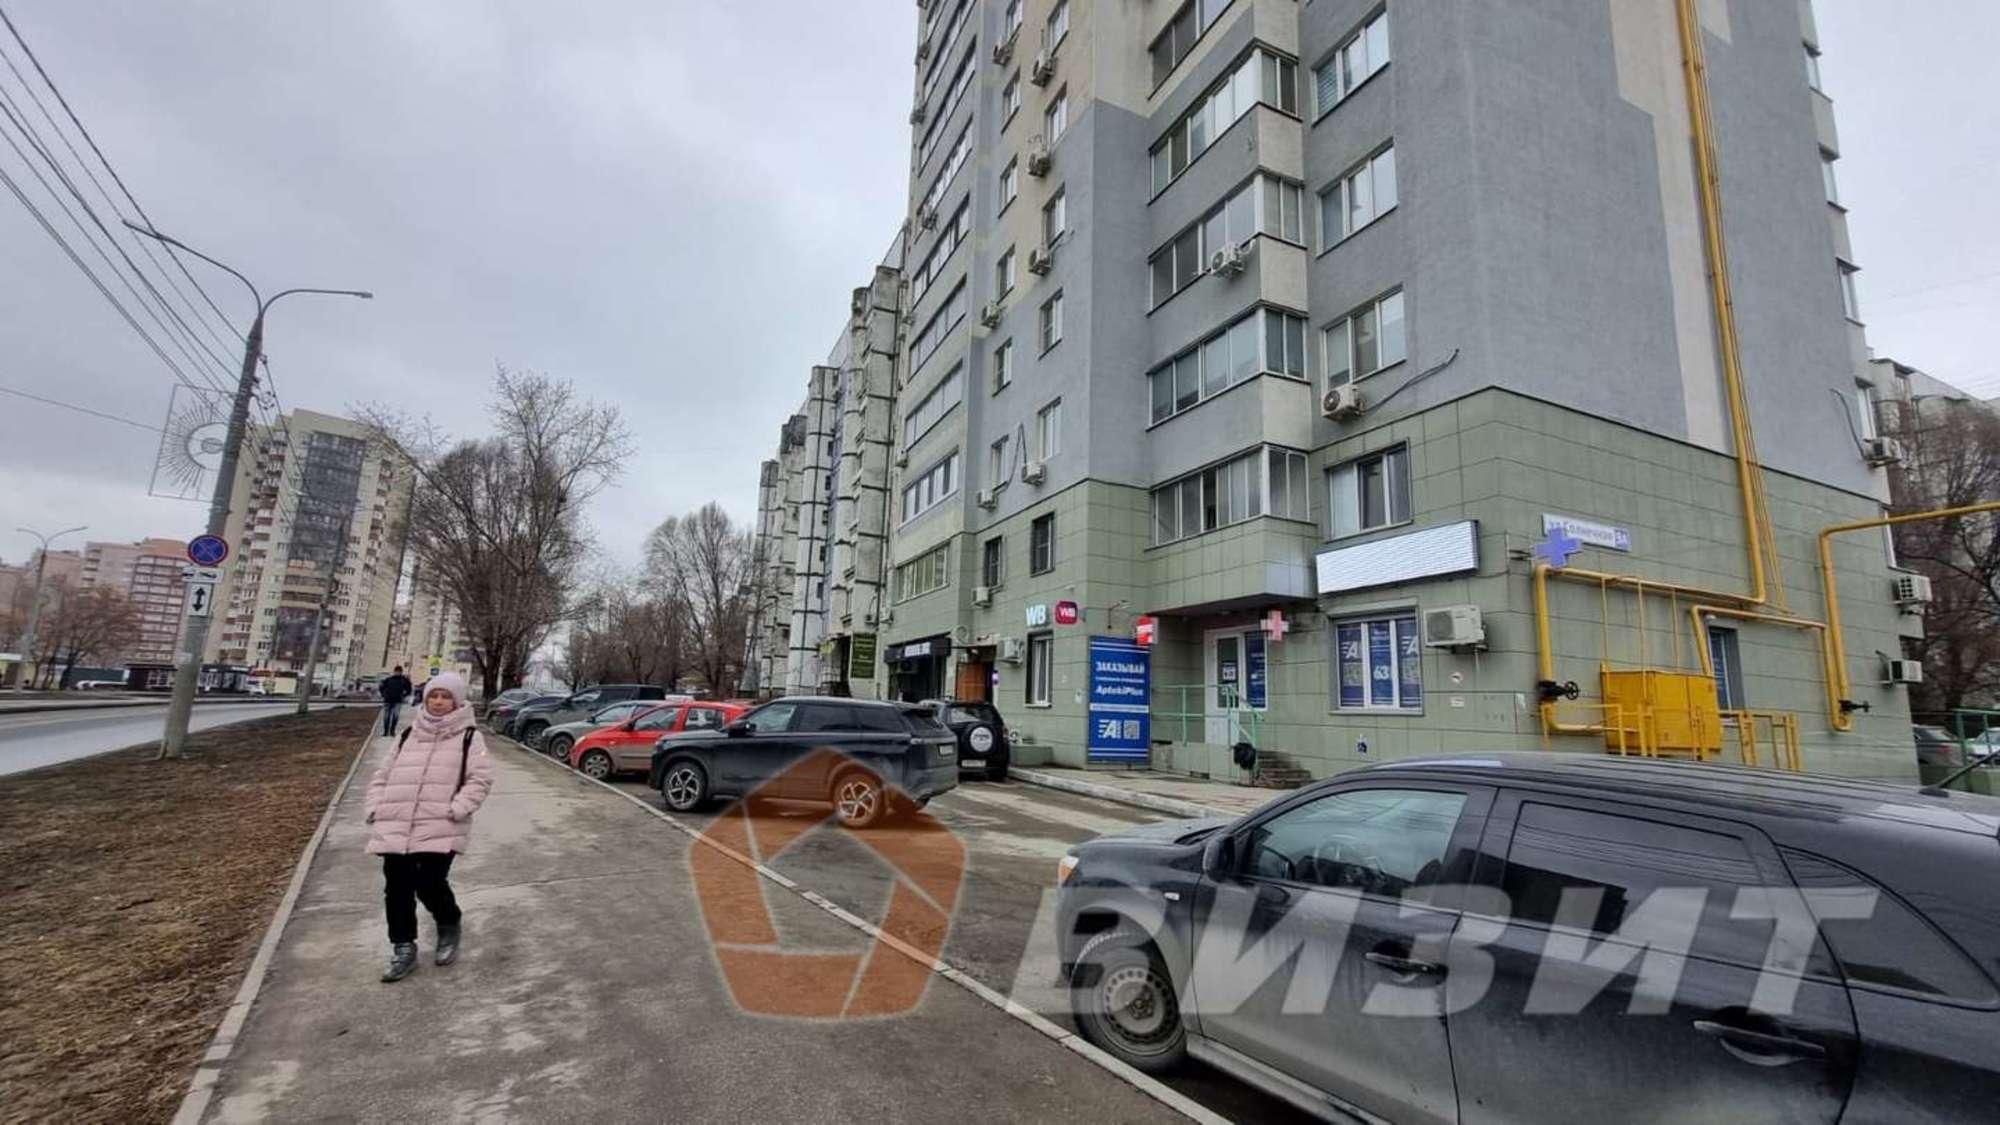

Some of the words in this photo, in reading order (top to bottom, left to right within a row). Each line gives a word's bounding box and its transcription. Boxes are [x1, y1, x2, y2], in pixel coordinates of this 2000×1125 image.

[1026, 604, 1047, 626] WB
[1095, 661, 1145, 674] ЗАКАЗЫВАЙ
[1374, 665, 1389, 680] 63
